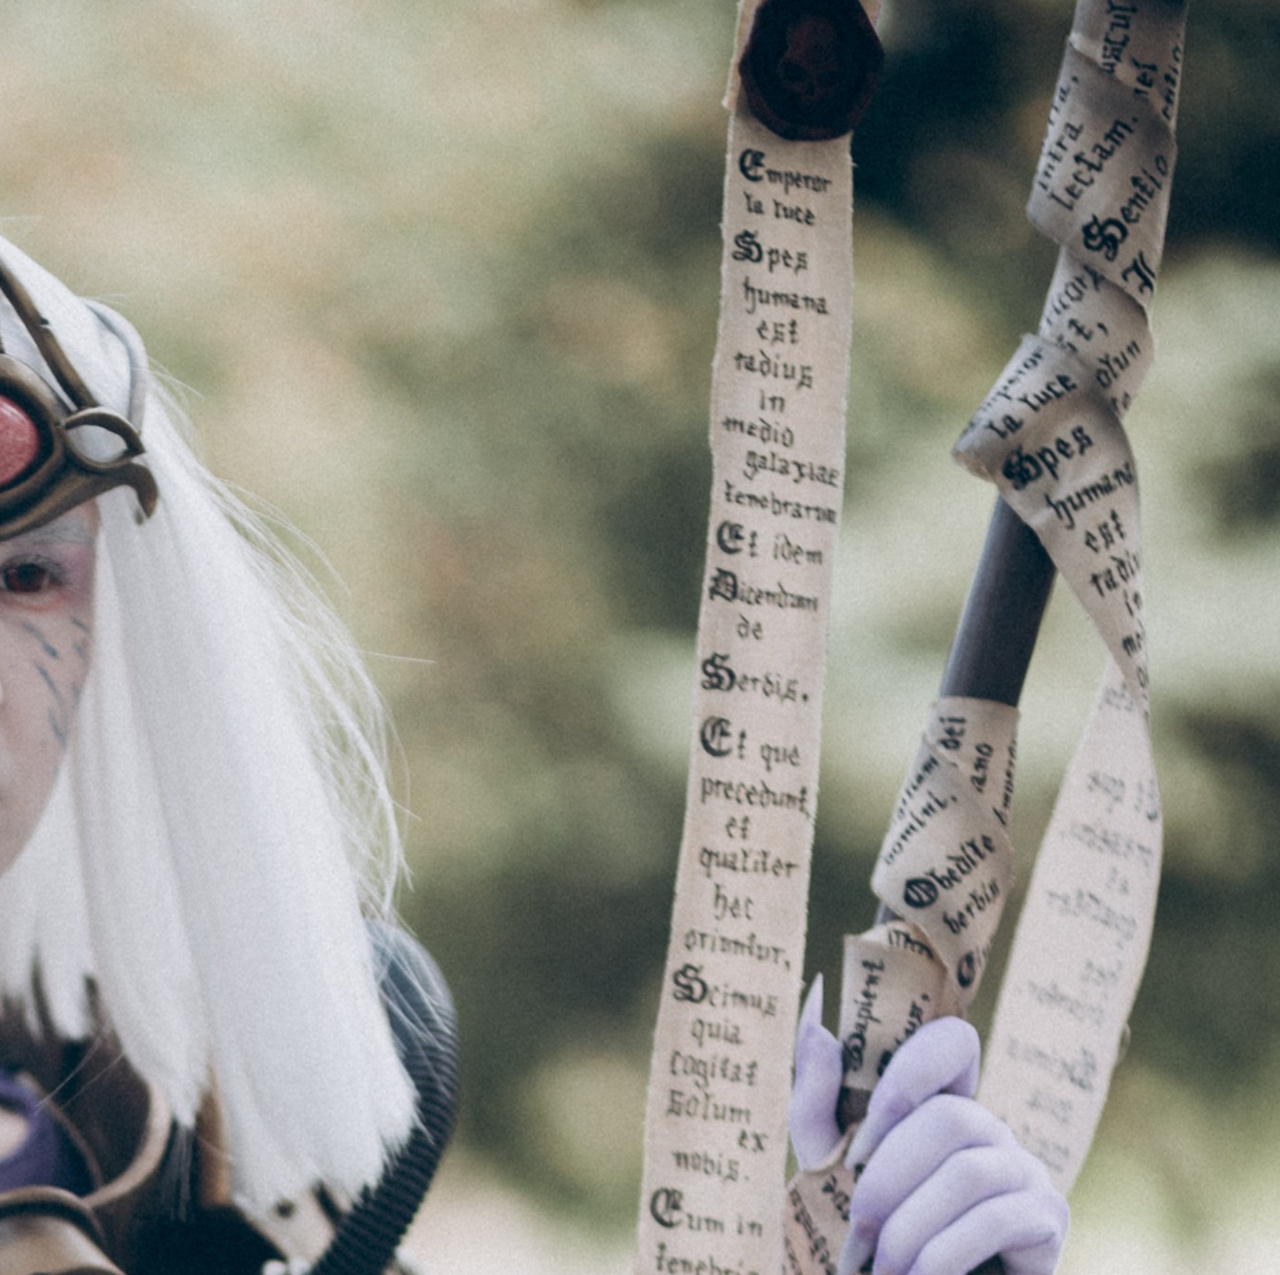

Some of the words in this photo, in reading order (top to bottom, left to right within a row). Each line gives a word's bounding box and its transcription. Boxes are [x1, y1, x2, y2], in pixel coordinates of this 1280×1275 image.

[738, 147, 832, 194] Emperor
[732, 230, 809, 272] Spes
[743, 277, 829, 316] humana
[756, 320, 799, 344] est
[733, 350, 813, 389] radius
[759, 389, 785, 413] in
[722, 417, 794, 448] medio
[1002, 425, 1094, 490] Spes
[737, 615, 763, 640] de
[725, 815, 750, 839] et
